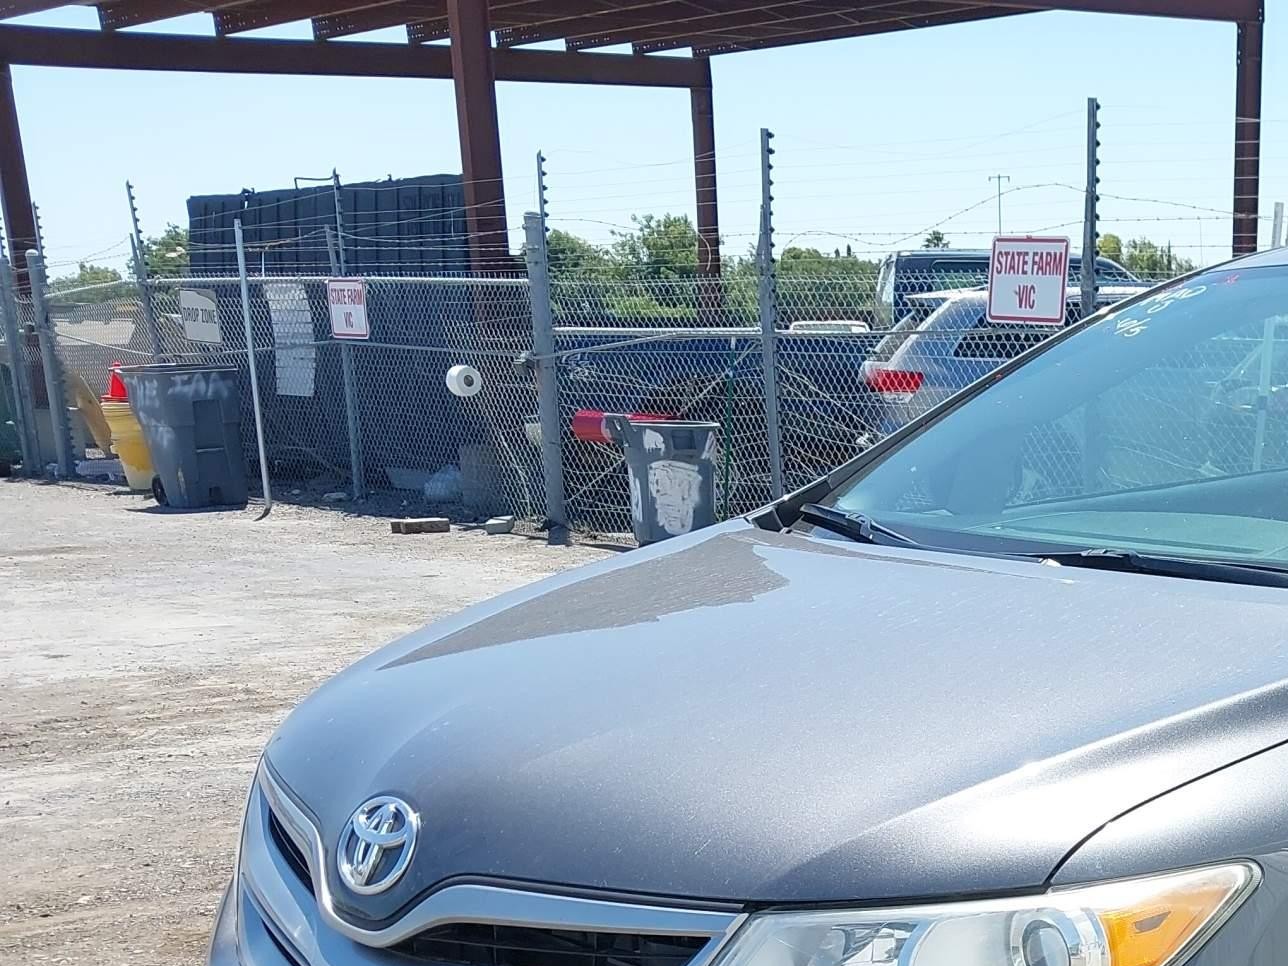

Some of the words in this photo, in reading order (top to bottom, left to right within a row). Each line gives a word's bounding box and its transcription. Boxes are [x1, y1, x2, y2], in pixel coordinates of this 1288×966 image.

[996, 250, 1029, 275] STATE
[1031, 251, 1063, 276] FARM
[330, 287, 347, 305] STATE
[346, 288, 363, 305] FARM
[1017, 284, 1036, 309] VIC
[182, 306, 199, 323] DROP
[200, 308, 217, 325] ZONE
